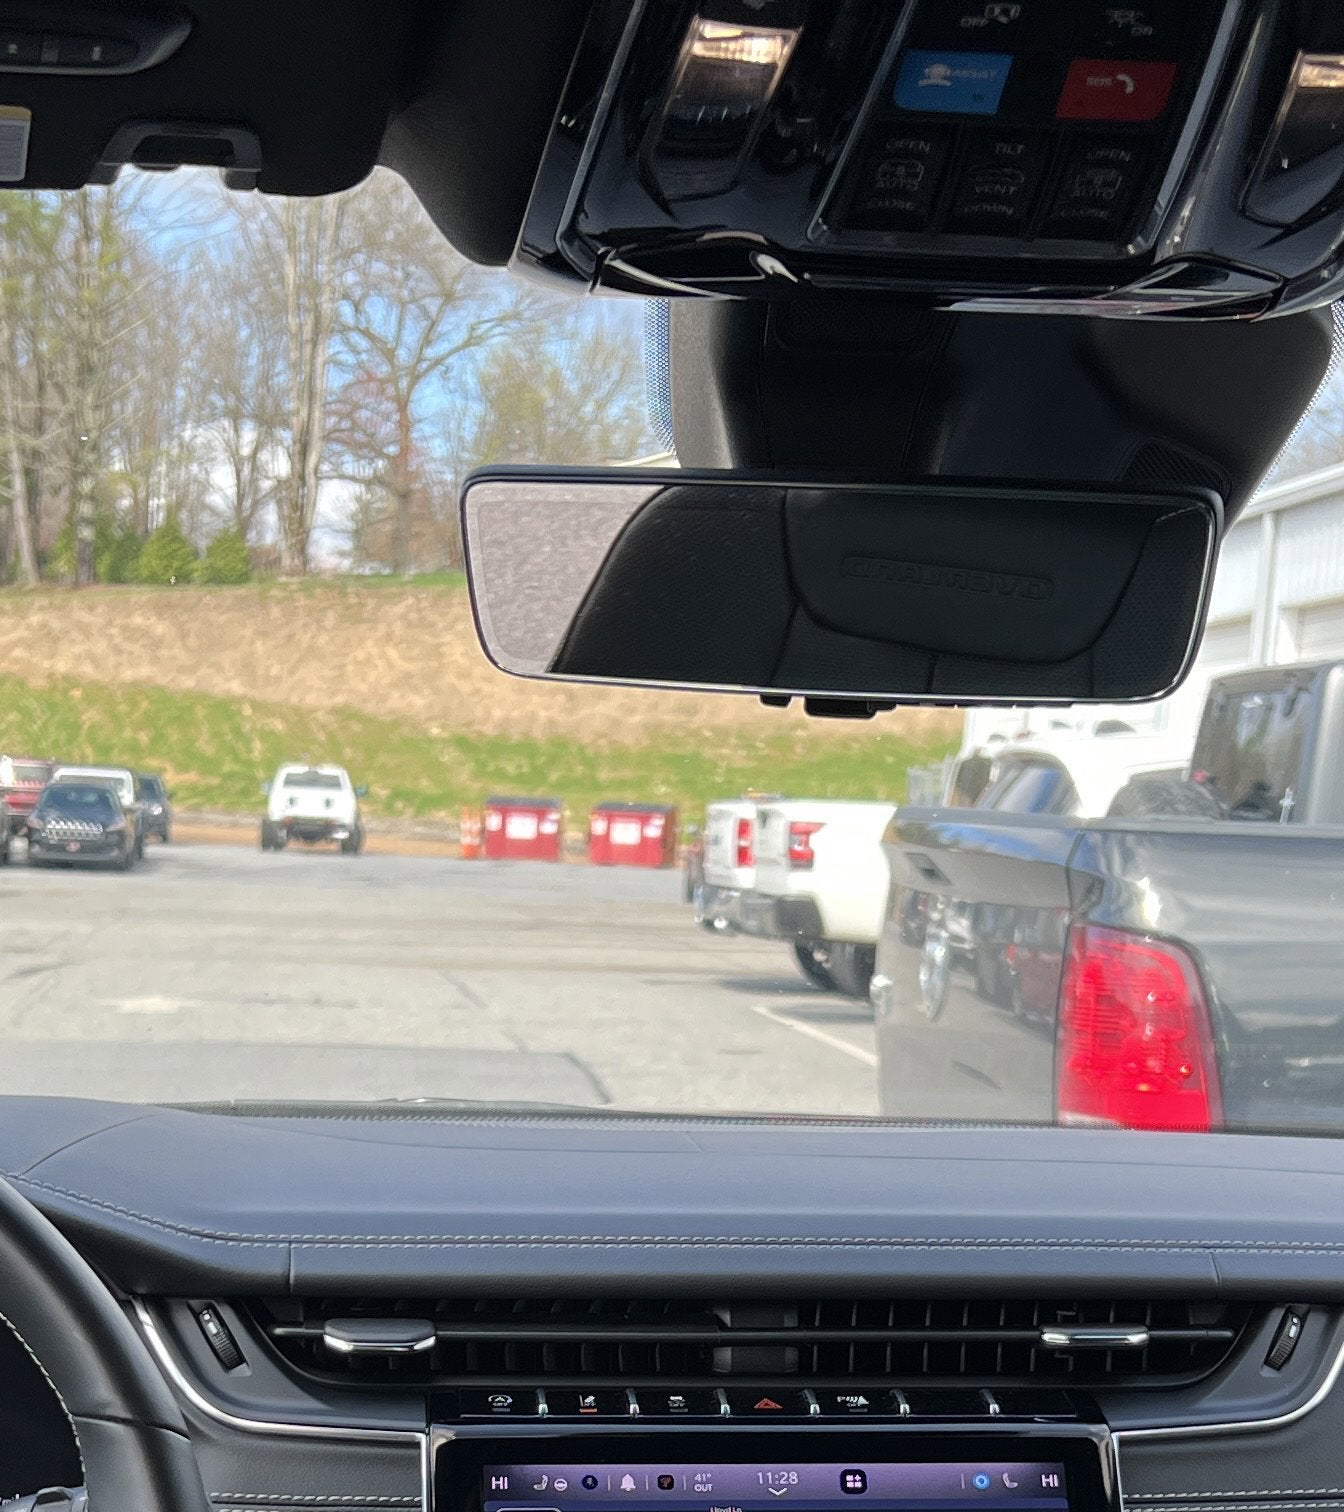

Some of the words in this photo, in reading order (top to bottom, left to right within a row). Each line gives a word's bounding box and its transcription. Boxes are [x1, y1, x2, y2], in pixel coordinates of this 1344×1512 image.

[491, 1475, 508, 1490] HI
[756, 1471, 799, 1485] 11:28
[1041, 1473, 1059, 1488] HI
[694, 1483, 713, 1492] OUT
